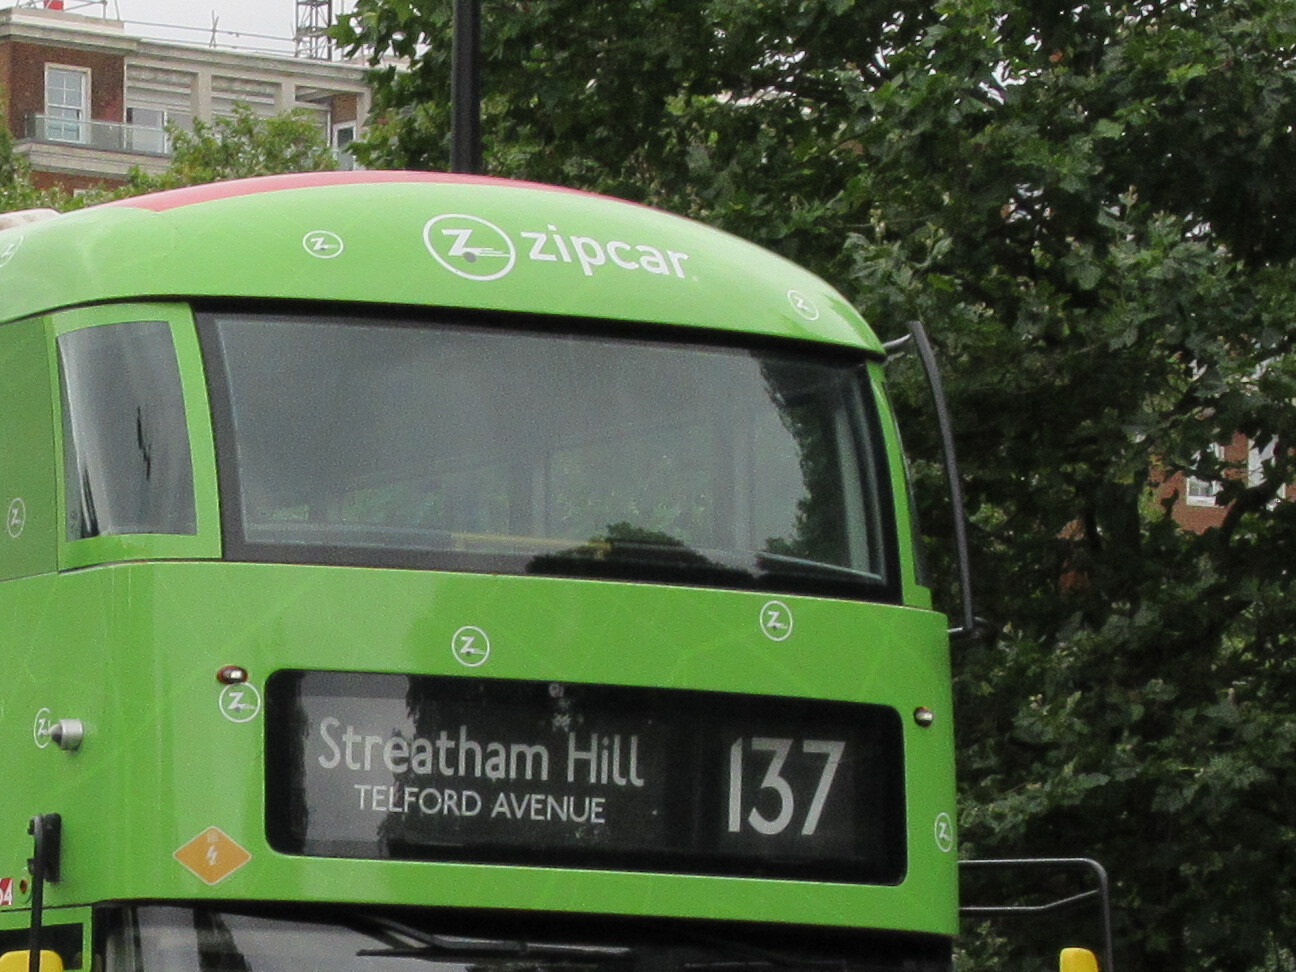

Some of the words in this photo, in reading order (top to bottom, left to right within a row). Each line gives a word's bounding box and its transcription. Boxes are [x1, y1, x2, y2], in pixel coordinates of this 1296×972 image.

[520, 226, 689, 279] zipcar
[318, 716, 550, 782] Streatham
[568, 733, 645, 788] Hill
[354, 784, 481, 818] TELFORD
[491, 791, 605, 824] AVENUE
[728, 736, 846, 836] 137
